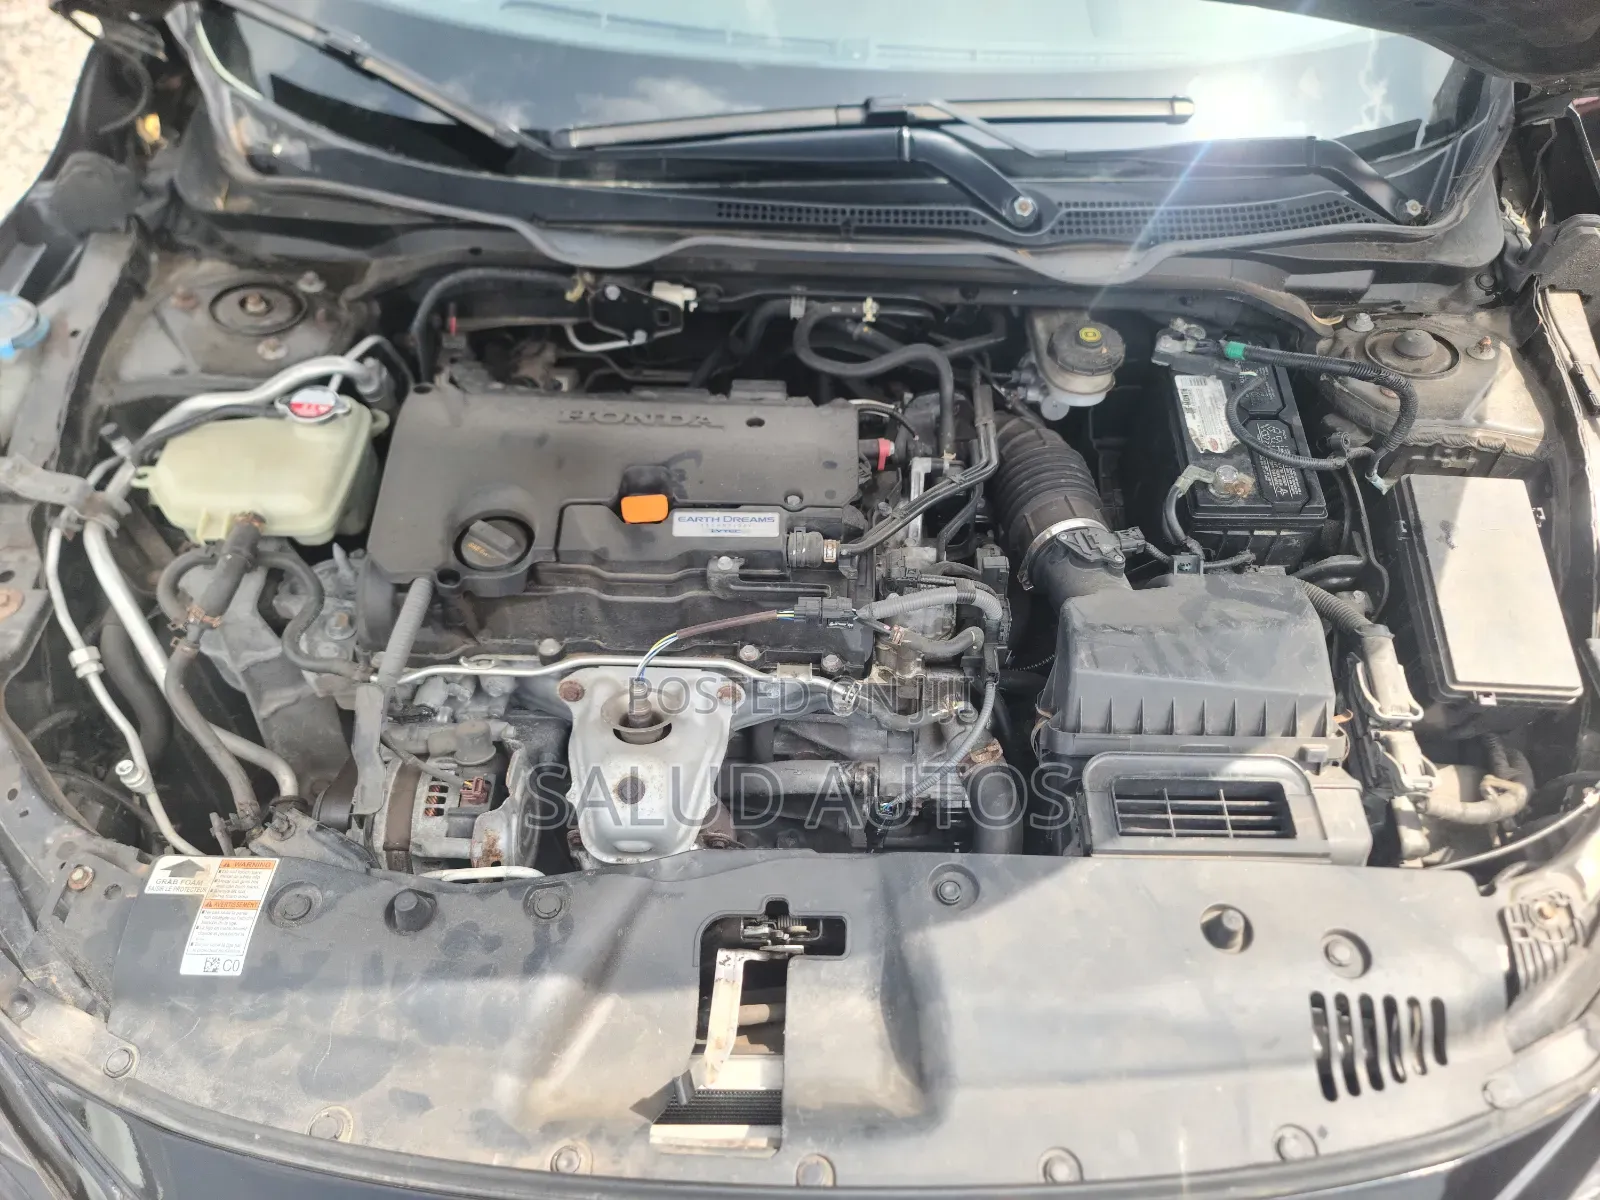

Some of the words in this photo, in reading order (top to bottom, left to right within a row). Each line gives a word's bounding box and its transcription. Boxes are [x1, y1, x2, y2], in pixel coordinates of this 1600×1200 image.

[557, 410, 725, 429] HONDA
[677, 515, 720, 523] EARTH
[723, 515, 775, 523] DREAMS
